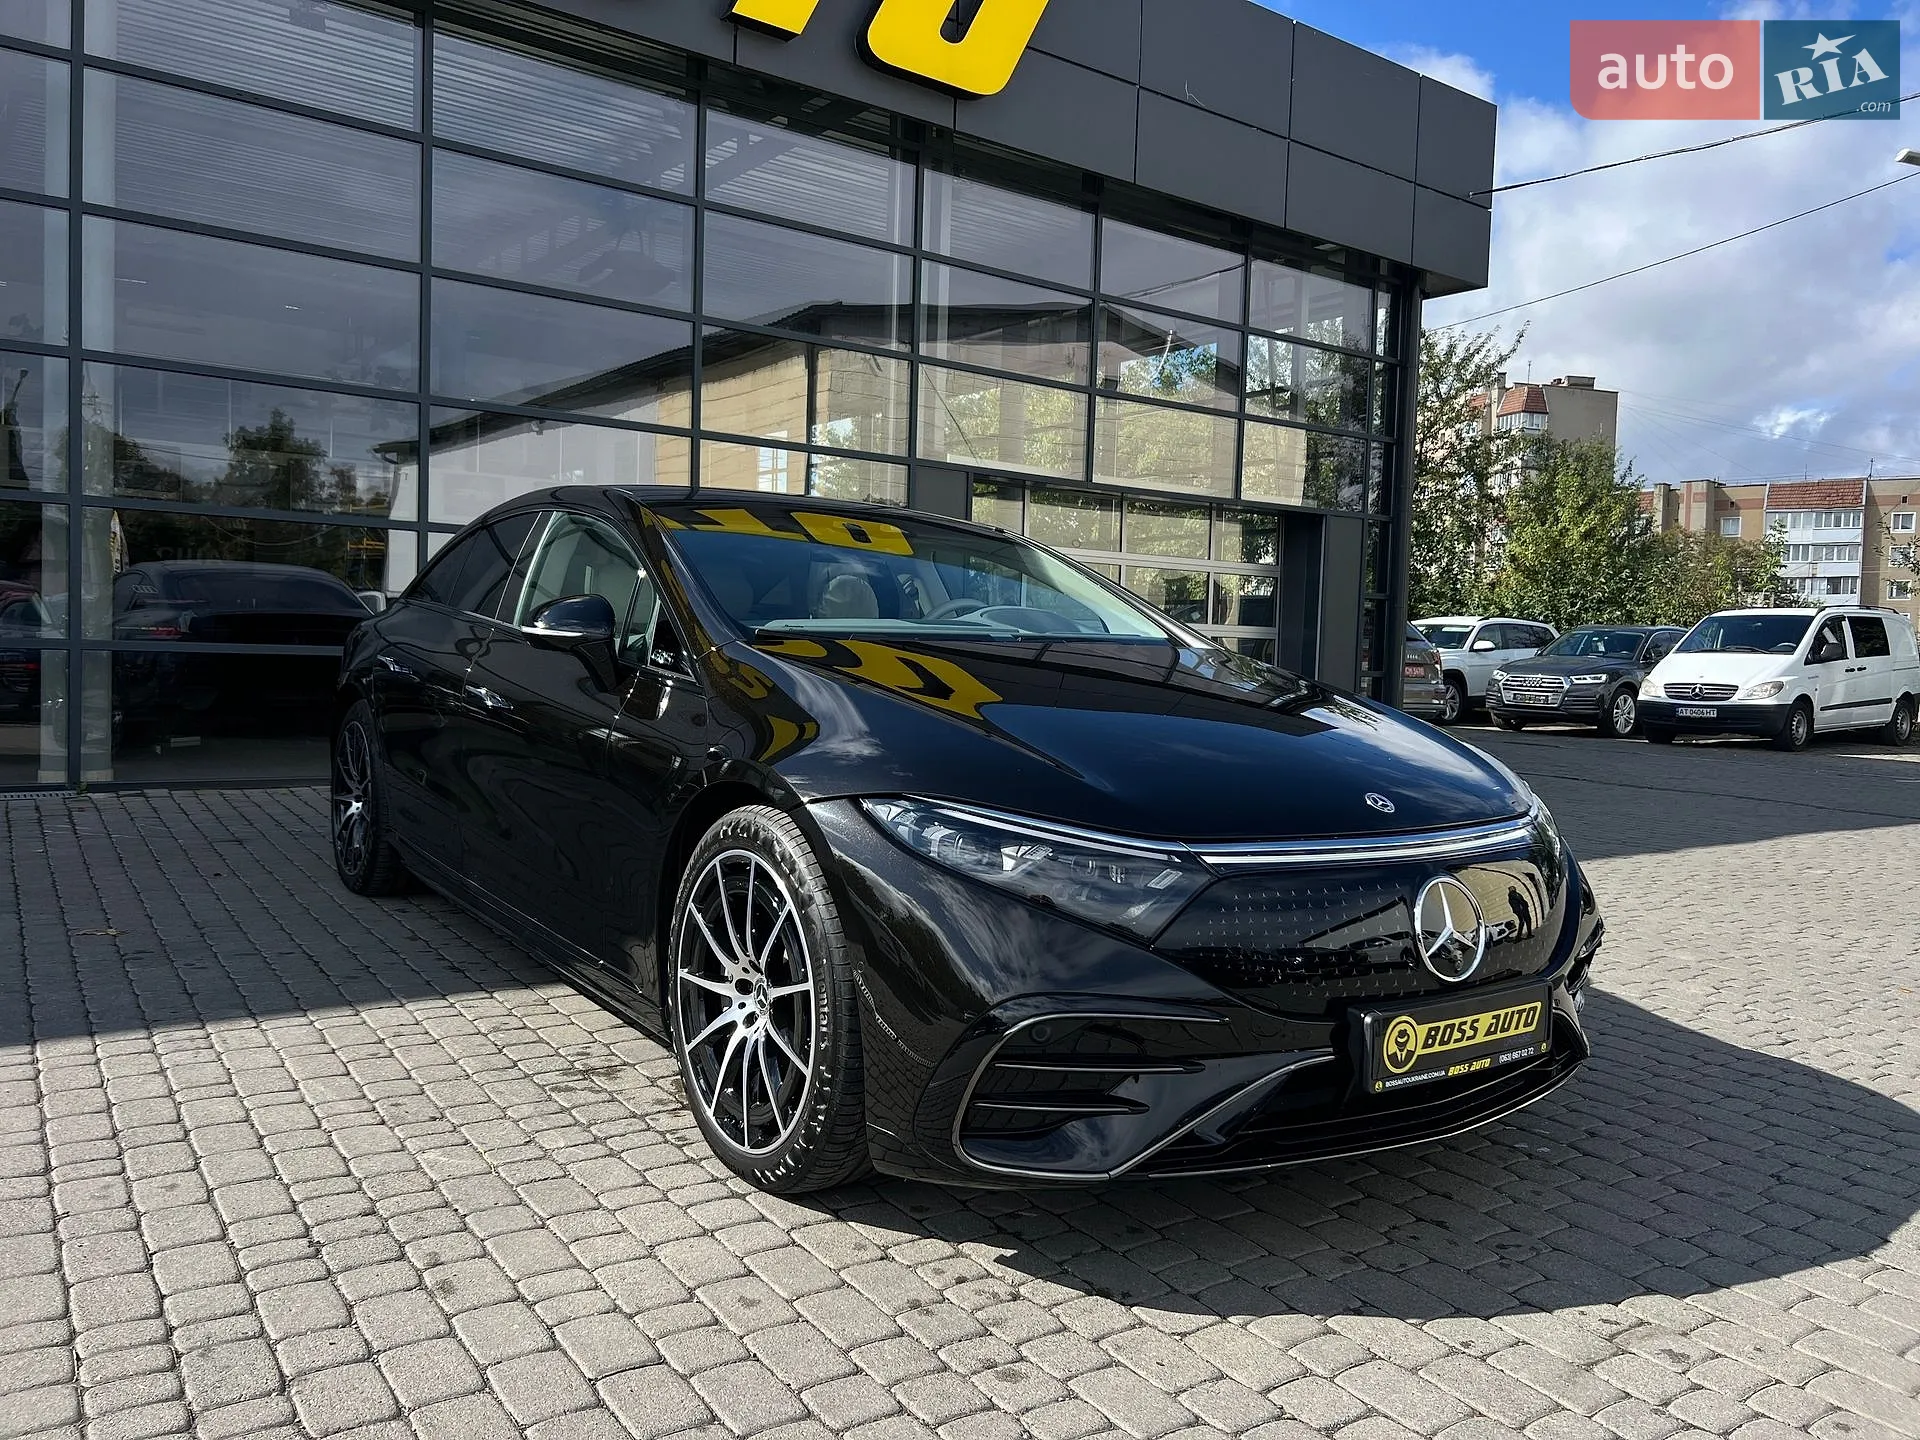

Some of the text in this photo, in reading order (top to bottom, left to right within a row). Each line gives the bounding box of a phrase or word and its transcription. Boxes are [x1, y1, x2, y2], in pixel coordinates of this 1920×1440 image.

[1421, 1018, 1480, 1049] BOSS
[1482, 1005, 1539, 1038] AUTO
[1447, 1063, 1469, 1076] BOSS
[1470, 1058, 1491, 1071] AUTO
